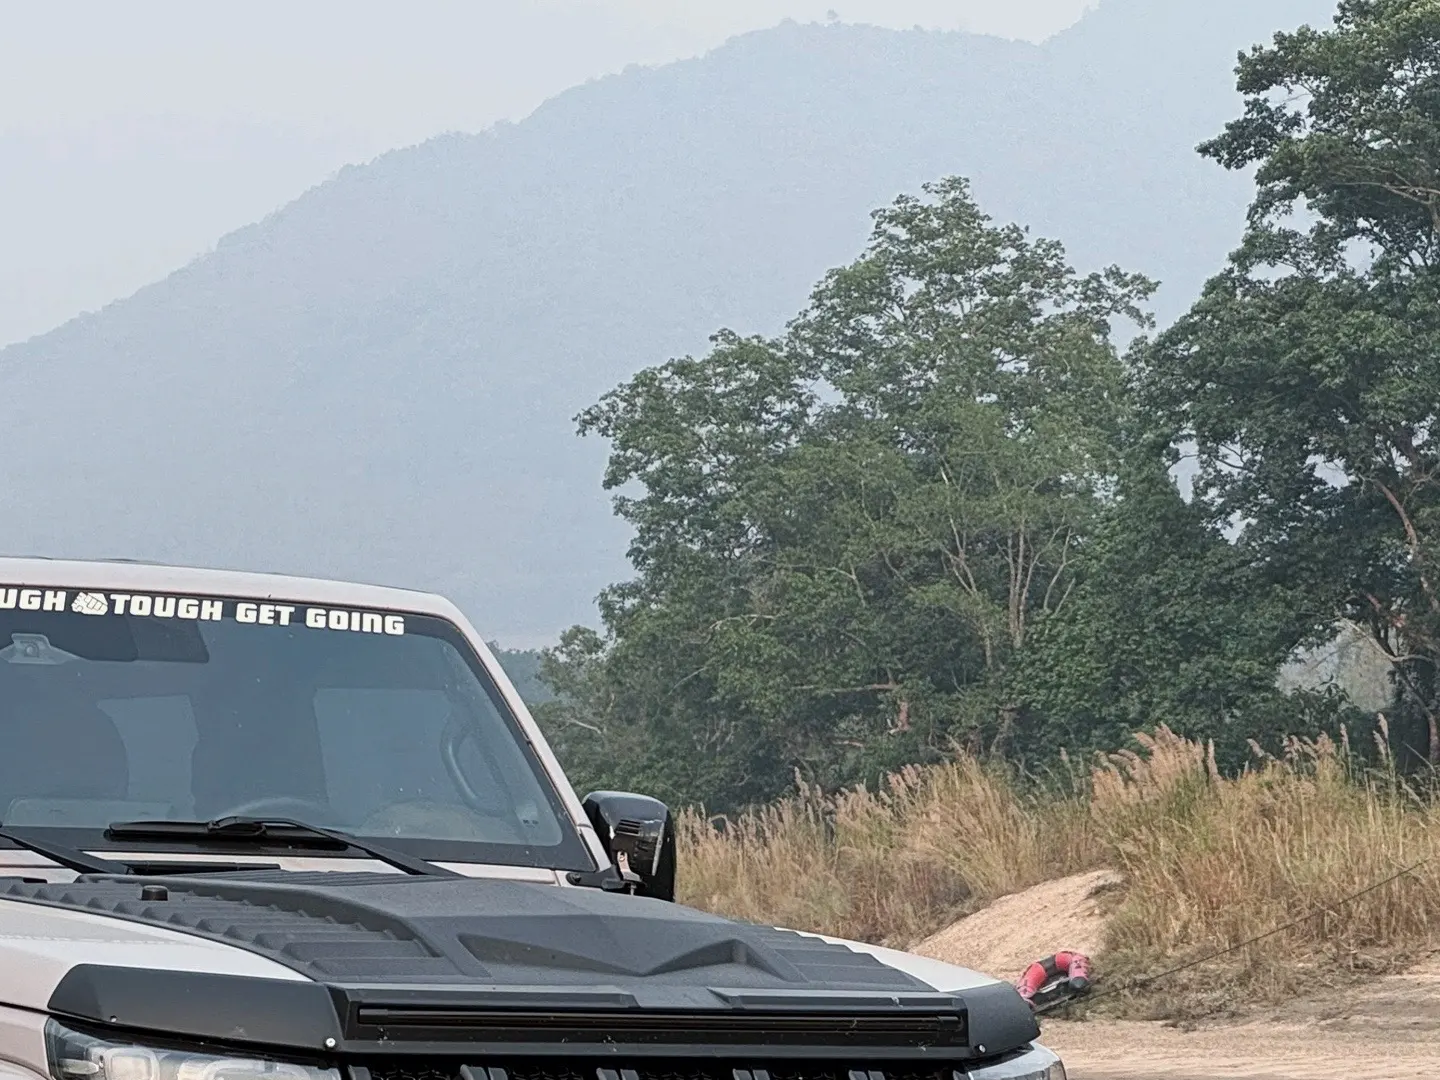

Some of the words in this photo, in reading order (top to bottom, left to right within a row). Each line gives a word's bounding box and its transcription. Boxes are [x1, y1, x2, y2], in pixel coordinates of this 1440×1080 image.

[110, 593, 223, 621] TOUGH
[235, 603, 295, 626] GET
[305, 608, 405, 635] GOING
